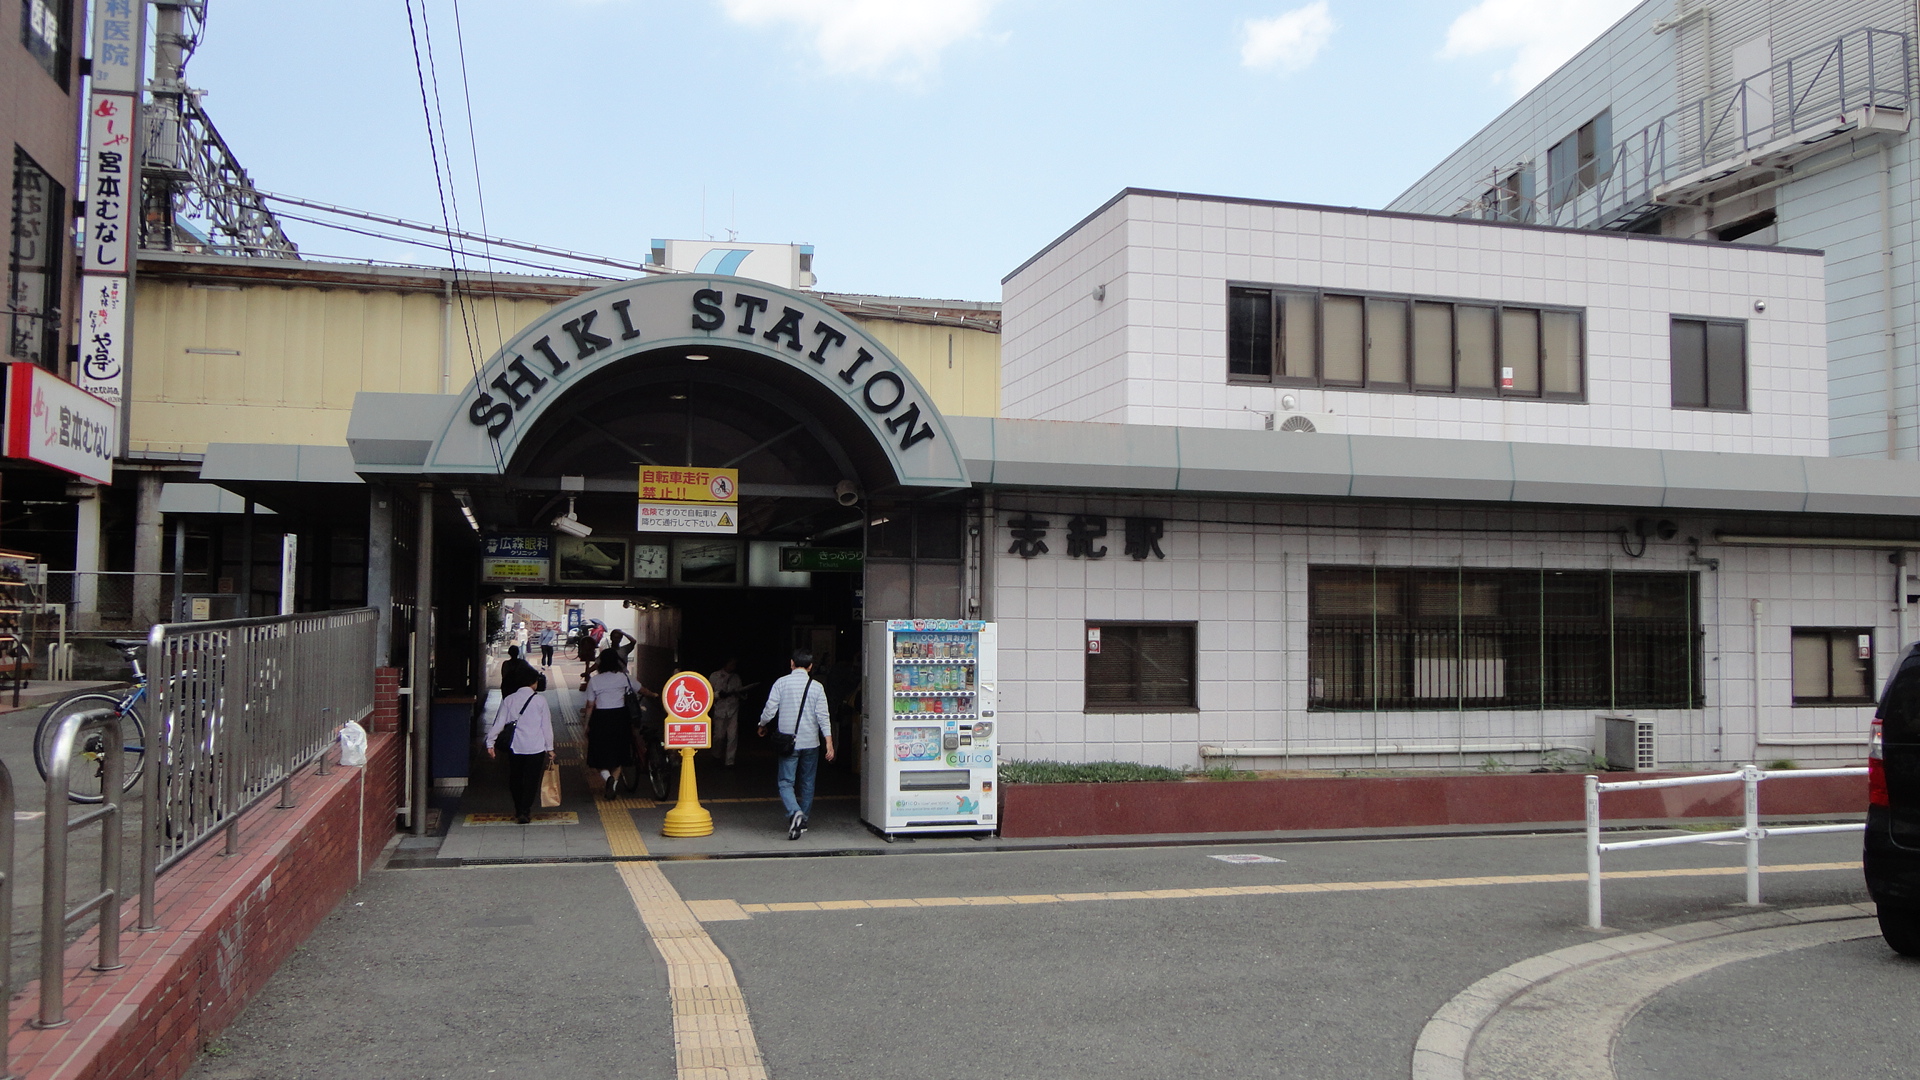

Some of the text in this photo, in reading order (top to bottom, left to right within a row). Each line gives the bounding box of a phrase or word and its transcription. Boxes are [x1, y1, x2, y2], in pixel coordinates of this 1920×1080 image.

[94, 99, 129, 265] めしや 宮本むなし
[469, 288, 936, 451] SHIKI STATION
[33, 386, 111, 461] めしや 宮本むなし
[642, 470, 710, 486] 自転車走行
[641, 507, 718, 518] 危険ですので自転車は
[641, 517, 717, 528] 降りて通行して下さい。
[499, 536, 549, 551] 広森眼科
[1006, 513, 1166, 560] 志紀駅
[949, 753, 992, 764] curico
